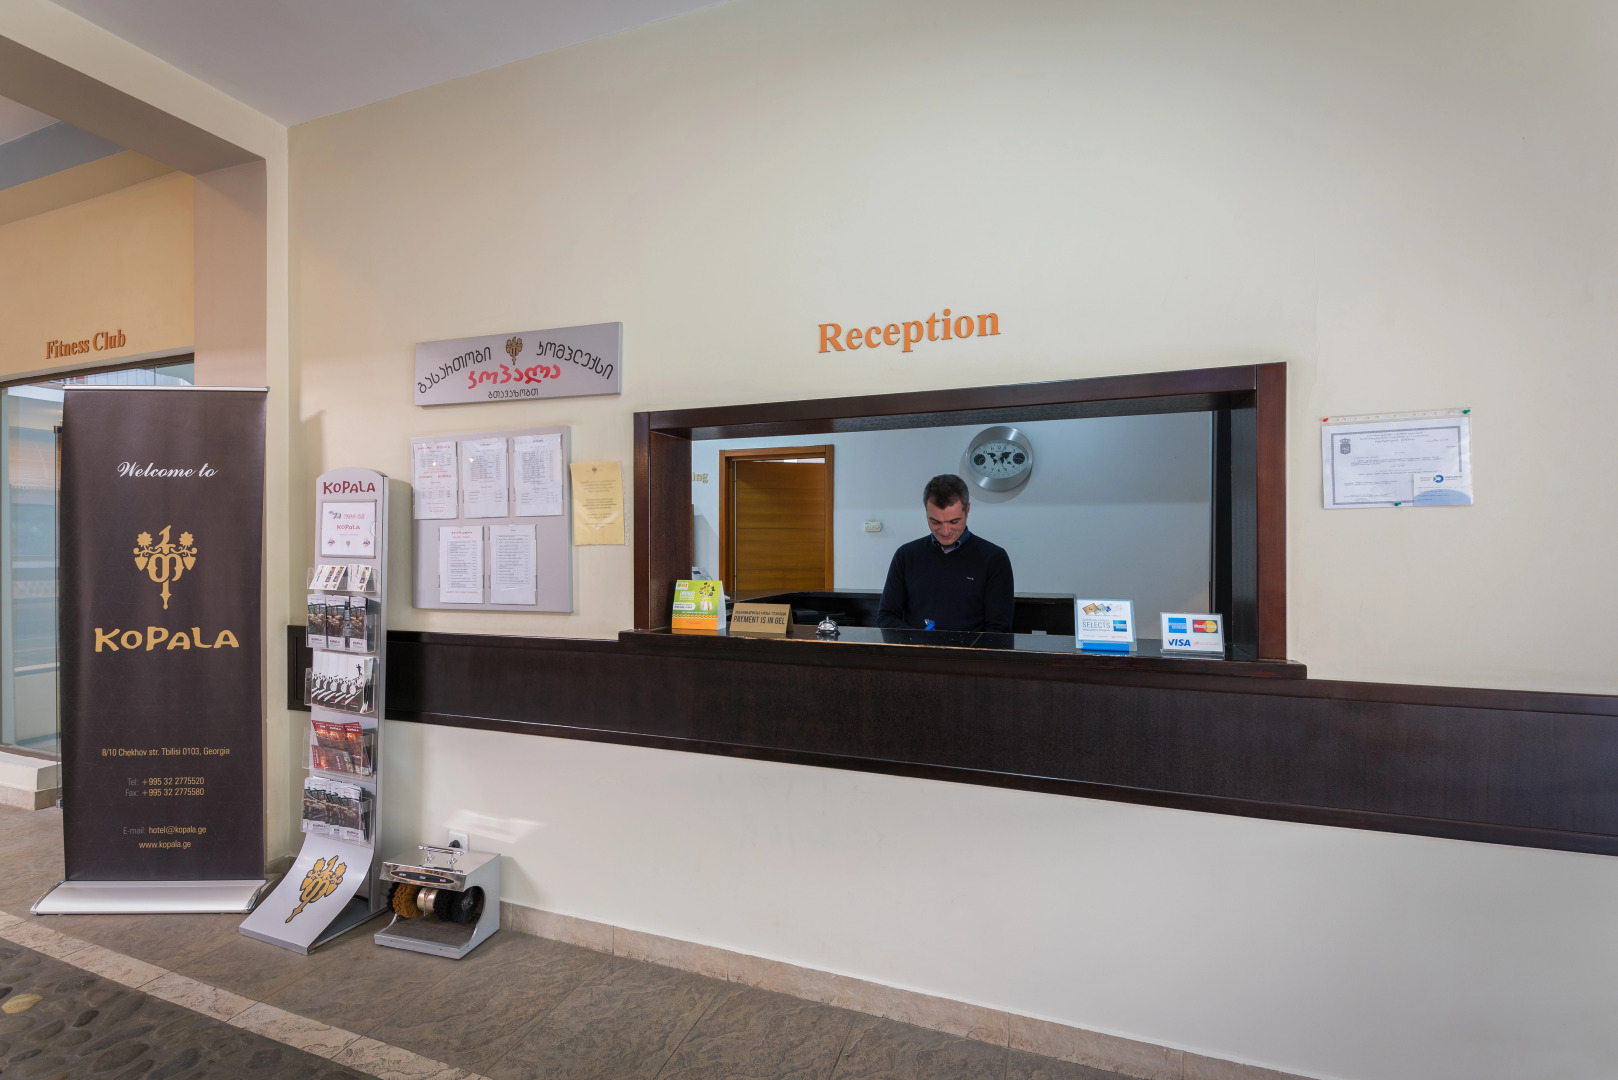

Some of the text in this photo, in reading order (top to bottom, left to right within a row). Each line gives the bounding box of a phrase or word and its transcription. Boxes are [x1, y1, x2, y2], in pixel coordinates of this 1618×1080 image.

[818, 308, 1001, 353] Reception
[45, 329, 126, 360] Fitness Club
[417, 341, 614, 393] გასართობი კომპლექსი
[467, 364, 561, 389] კოპალა
[117, 461, 219, 478] Welcome to
[322, 480, 376, 495] KOPALA
[733, 615, 785, 625] PAYMENT IS IN GEL
[1082, 621, 1111, 629] SELECTS
[94, 626, 240, 653] KOPALA
[1167, 638, 1191, 647] VISA
[101, 746, 230, 757] 8/10 Chekhov str. Tbilisi 0103, Georgia
[127, 777, 205, 786] Tel: +995 32 2775520
[125, 788, 205, 797] Fax: +995 32 2775580
[123, 825, 207, 836] E-mail: hotel@kopala.ge
[138, 840, 192, 850] www.kopala.ge
